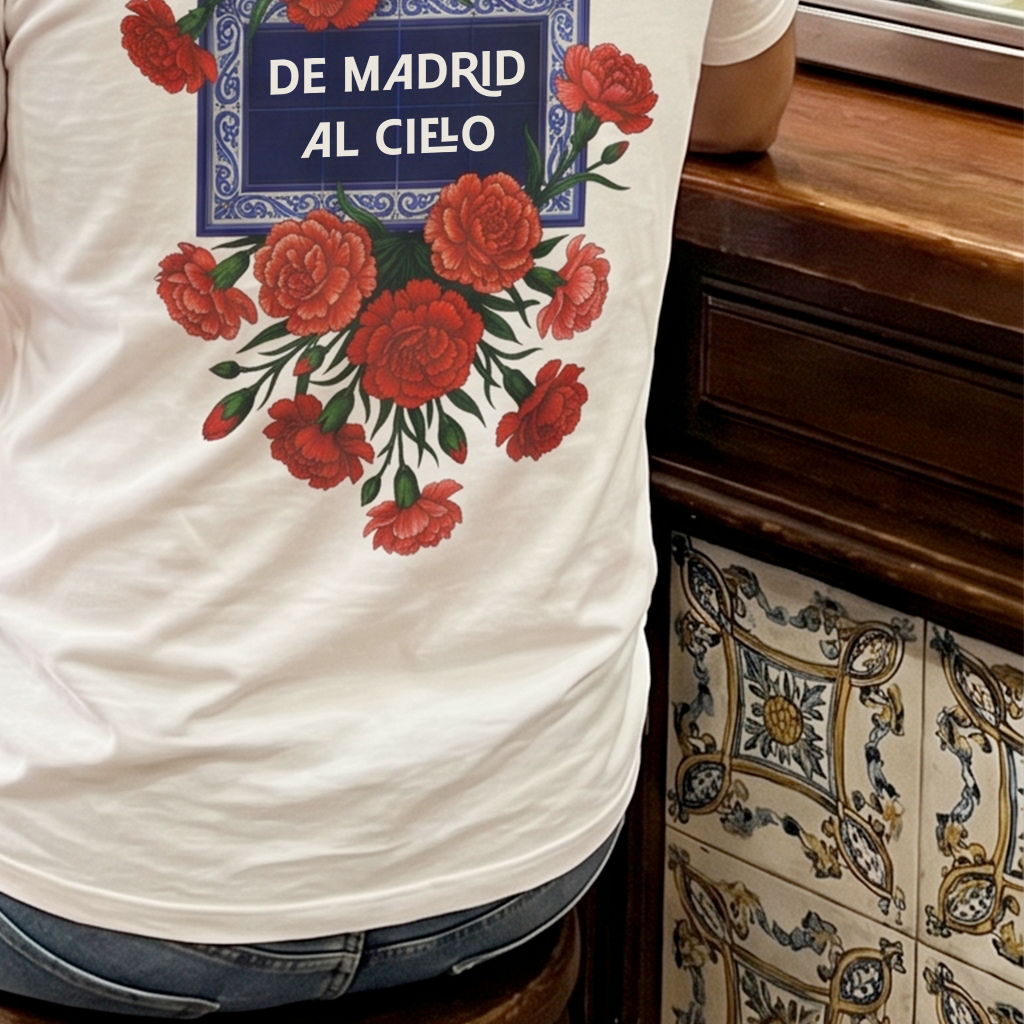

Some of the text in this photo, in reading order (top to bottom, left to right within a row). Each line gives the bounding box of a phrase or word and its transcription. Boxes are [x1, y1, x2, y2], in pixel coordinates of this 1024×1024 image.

[270, 49, 525, 97] DE MADRID
[301, 115, 495, 158] AL CIELO
